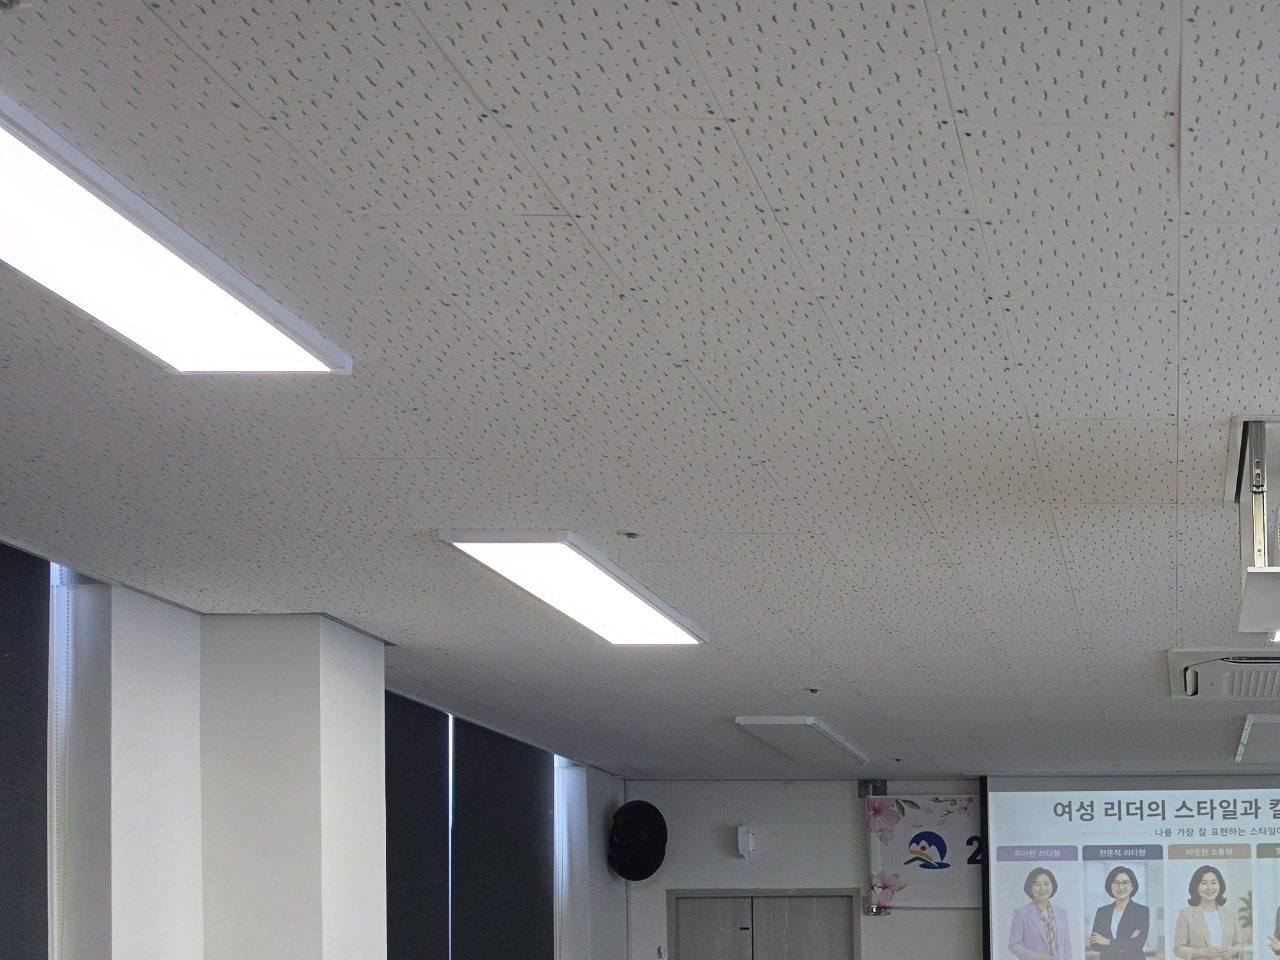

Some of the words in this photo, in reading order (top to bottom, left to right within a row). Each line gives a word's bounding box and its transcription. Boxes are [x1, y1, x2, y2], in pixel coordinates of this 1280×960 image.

[1053, 800, 1095, 822] 여성
[1103, 799, 1166, 822] 리더의
[1174, 798, 1262, 821] 스타일과
[1154, 827, 1173, 838] 나를
[1176, 827, 1195, 838] 가장
[1197, 827, 1207, 838] 잘
[1210, 826, 1246, 838] 표현하는
[1013, 850, 1036, 858] 우아한
[1038, 850, 1061, 858] 리더형
[1099, 849, 1122, 858] 전문적
[1124, 849, 1146, 857] 리더형
[1186, 848, 1209, 856] 따뜻한
[1210, 848, 1233, 856] 소통형
